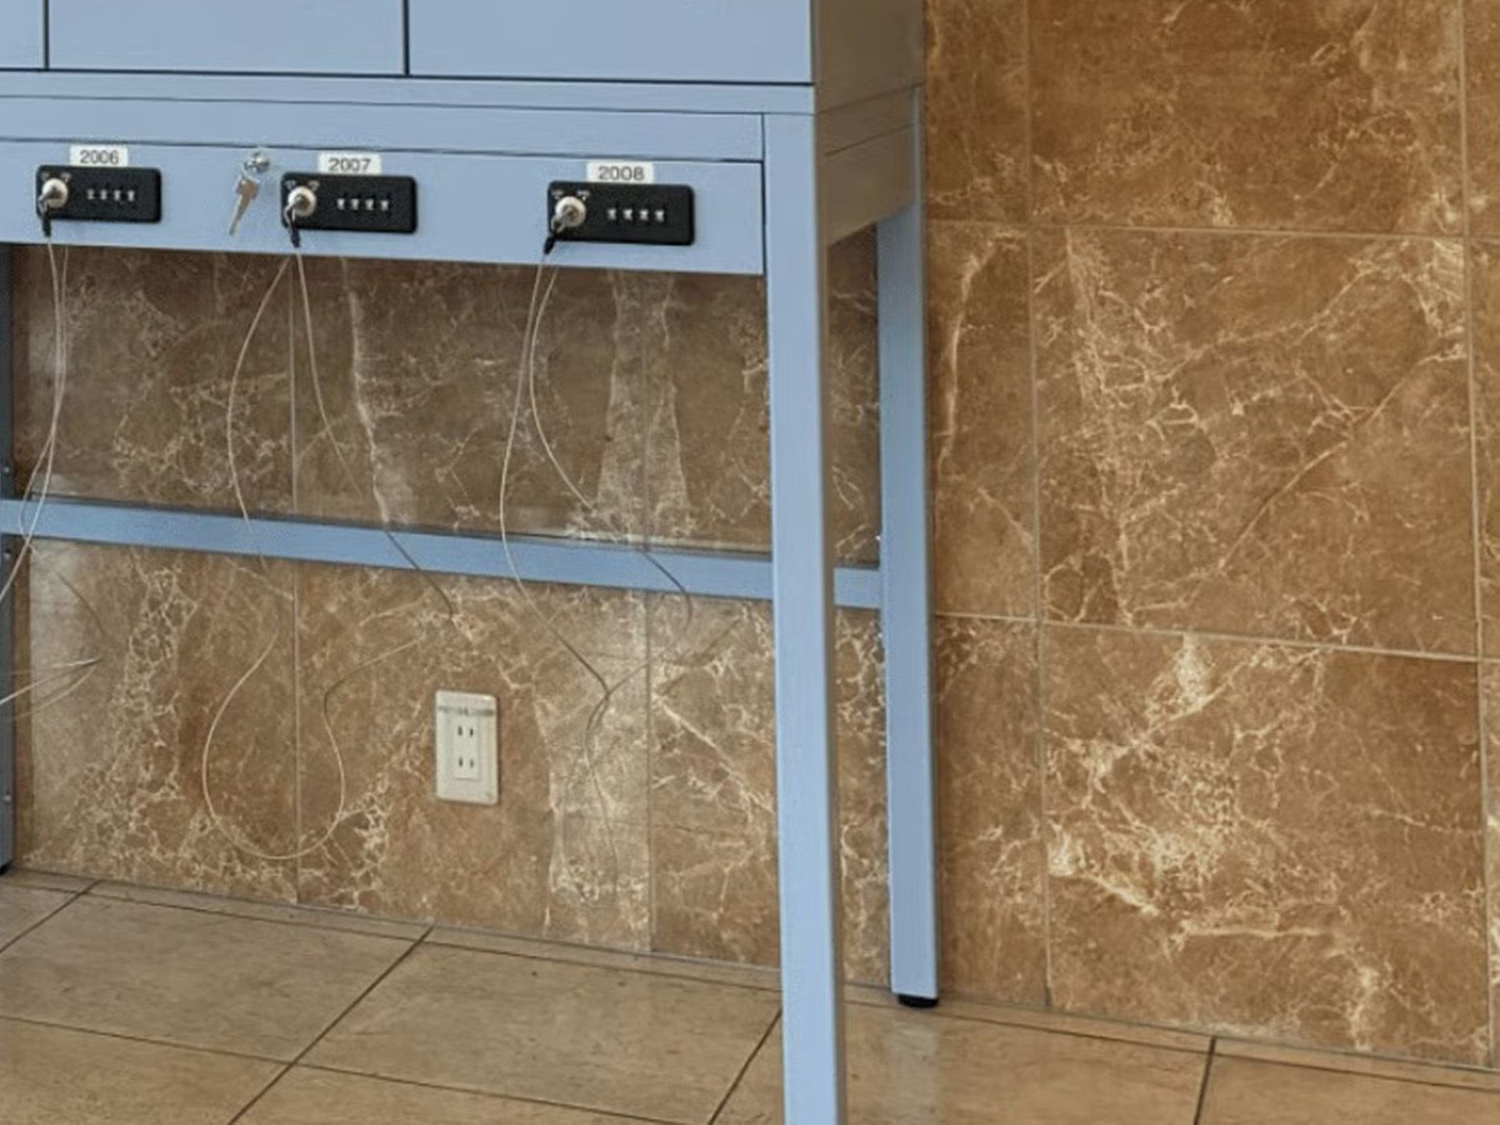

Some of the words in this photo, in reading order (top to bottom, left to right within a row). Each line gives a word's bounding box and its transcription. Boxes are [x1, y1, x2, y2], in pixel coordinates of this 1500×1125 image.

[79, 149, 120, 165] 2006
[328, 158, 371, 172] 2007
[598, 165, 645, 181] 2008
